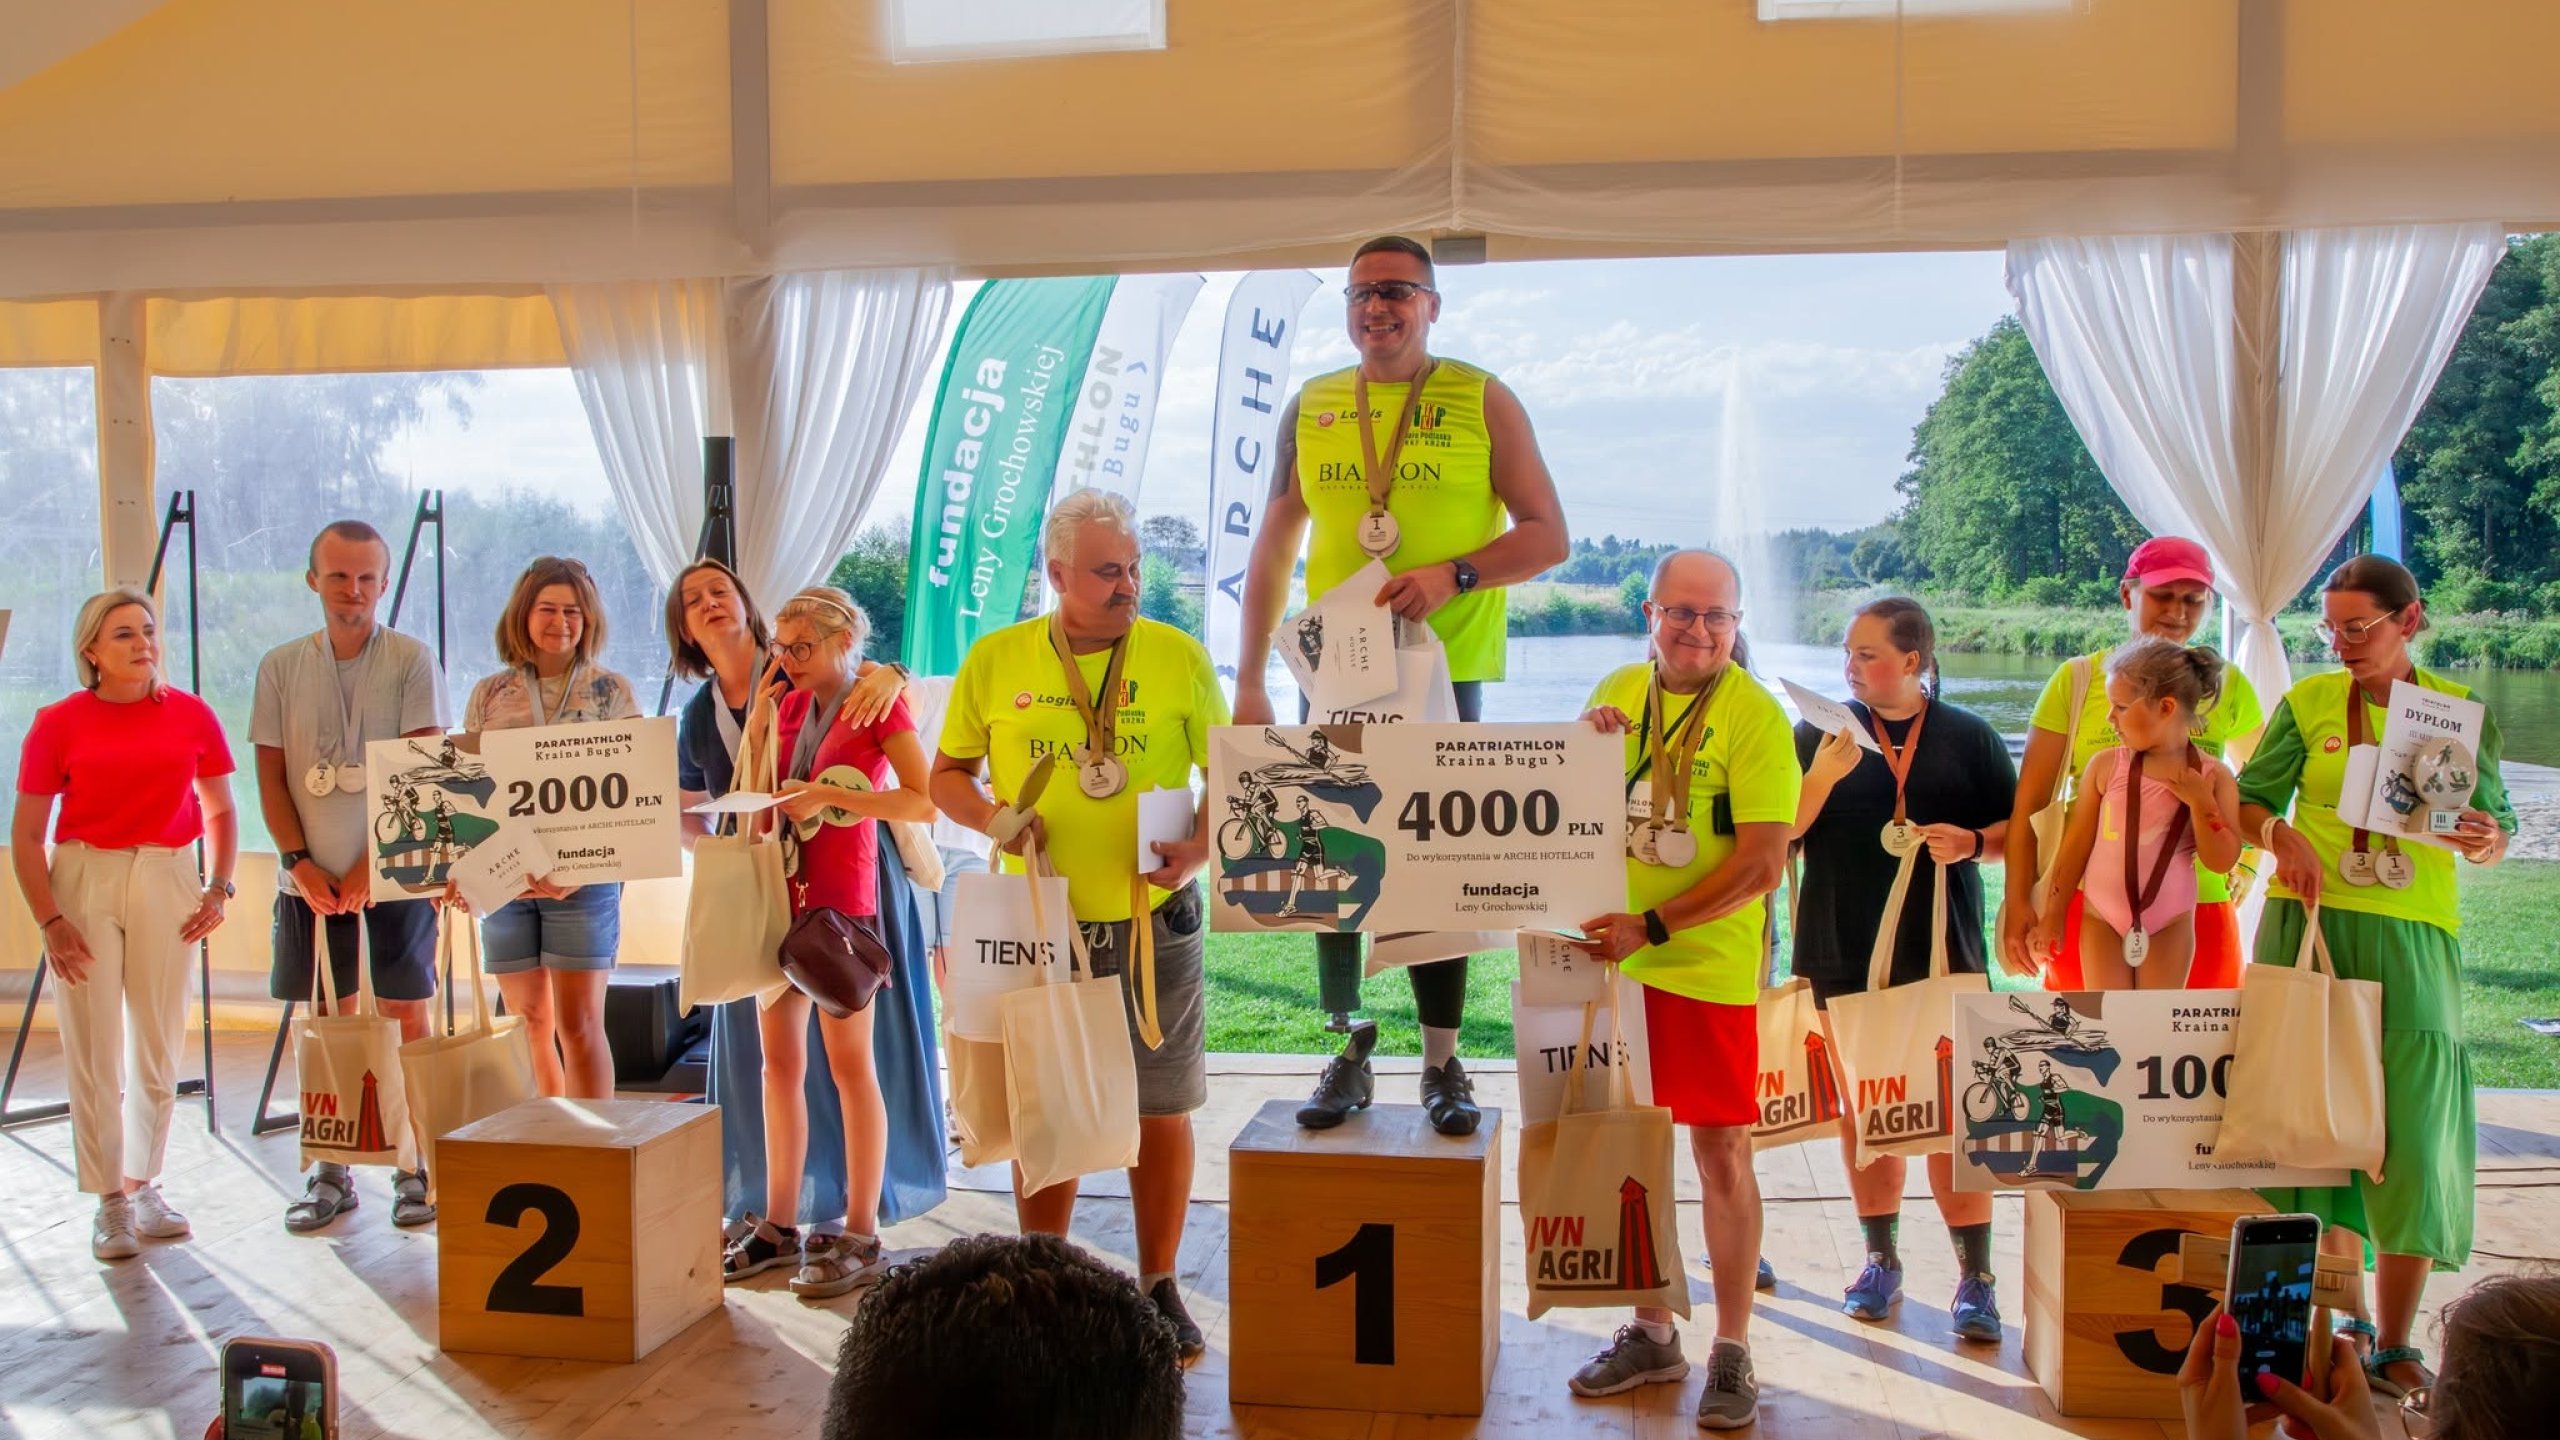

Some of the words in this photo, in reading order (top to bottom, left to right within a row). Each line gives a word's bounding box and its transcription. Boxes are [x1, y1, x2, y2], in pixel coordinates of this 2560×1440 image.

[979, 344, 1065, 540] Grochowskiej
[1102, 392, 1140, 478] Bugu
[1217, 307, 1285, 608] ARCHE
[928, 357, 1008, 588] fundacja
[1319, 462, 1440, 482] BIAON
[960, 546, 1002, 619] Leny
[2404, 707, 2462, 733] DYPLOM
[535, 733, 632, 749] PARATRIATHLON
[535, 748, 581, 761] Kraina
[586, 744, 620, 759] Bugu
[1029, 734, 1148, 759] BIAON
[1435, 739, 1565, 752] PARATRIATHLON
[1435, 753, 1496, 767] Kraina
[1504, 753, 1549, 768] Bugu
[508, 771, 629, 818] 2000
[635, 795, 662, 808] PLN
[1397, 789, 1560, 841] 4000
[1568, 821, 1604, 836] PLN
[1896, 827, 1904, 838] 3
[557, 846, 615, 860] fundacja
[1406, 852, 1419, 861] Do
[1421, 851, 1490, 863] wykorzystania
[1503, 851, 1538, 861] ARCHE
[1539, 851, 1595, 861] HOTELACH
[2357, 854, 2366, 866] 3
[2390, 857, 2400, 868] 1
[1462, 883, 1539, 898] fundacja
[1455, 902, 1480, 914] Leny
[1481, 900, 1548, 913] Grochowskiej
[2172, 1020, 2230, 1033] Kraina
[2136, 1053, 2235, 1100] 100
[1866, 1100, 1934, 1136] AGRI
[2142, 1113, 2156, 1123] Do
[300, 1118, 355, 1144] AGRI
[485, 1182, 584, 1316] 2
[1536, 1248, 1613, 1281] AGRI
[1315, 1222, 1395, 1366] 1
[2114, 1227, 2221, 1375] 3
